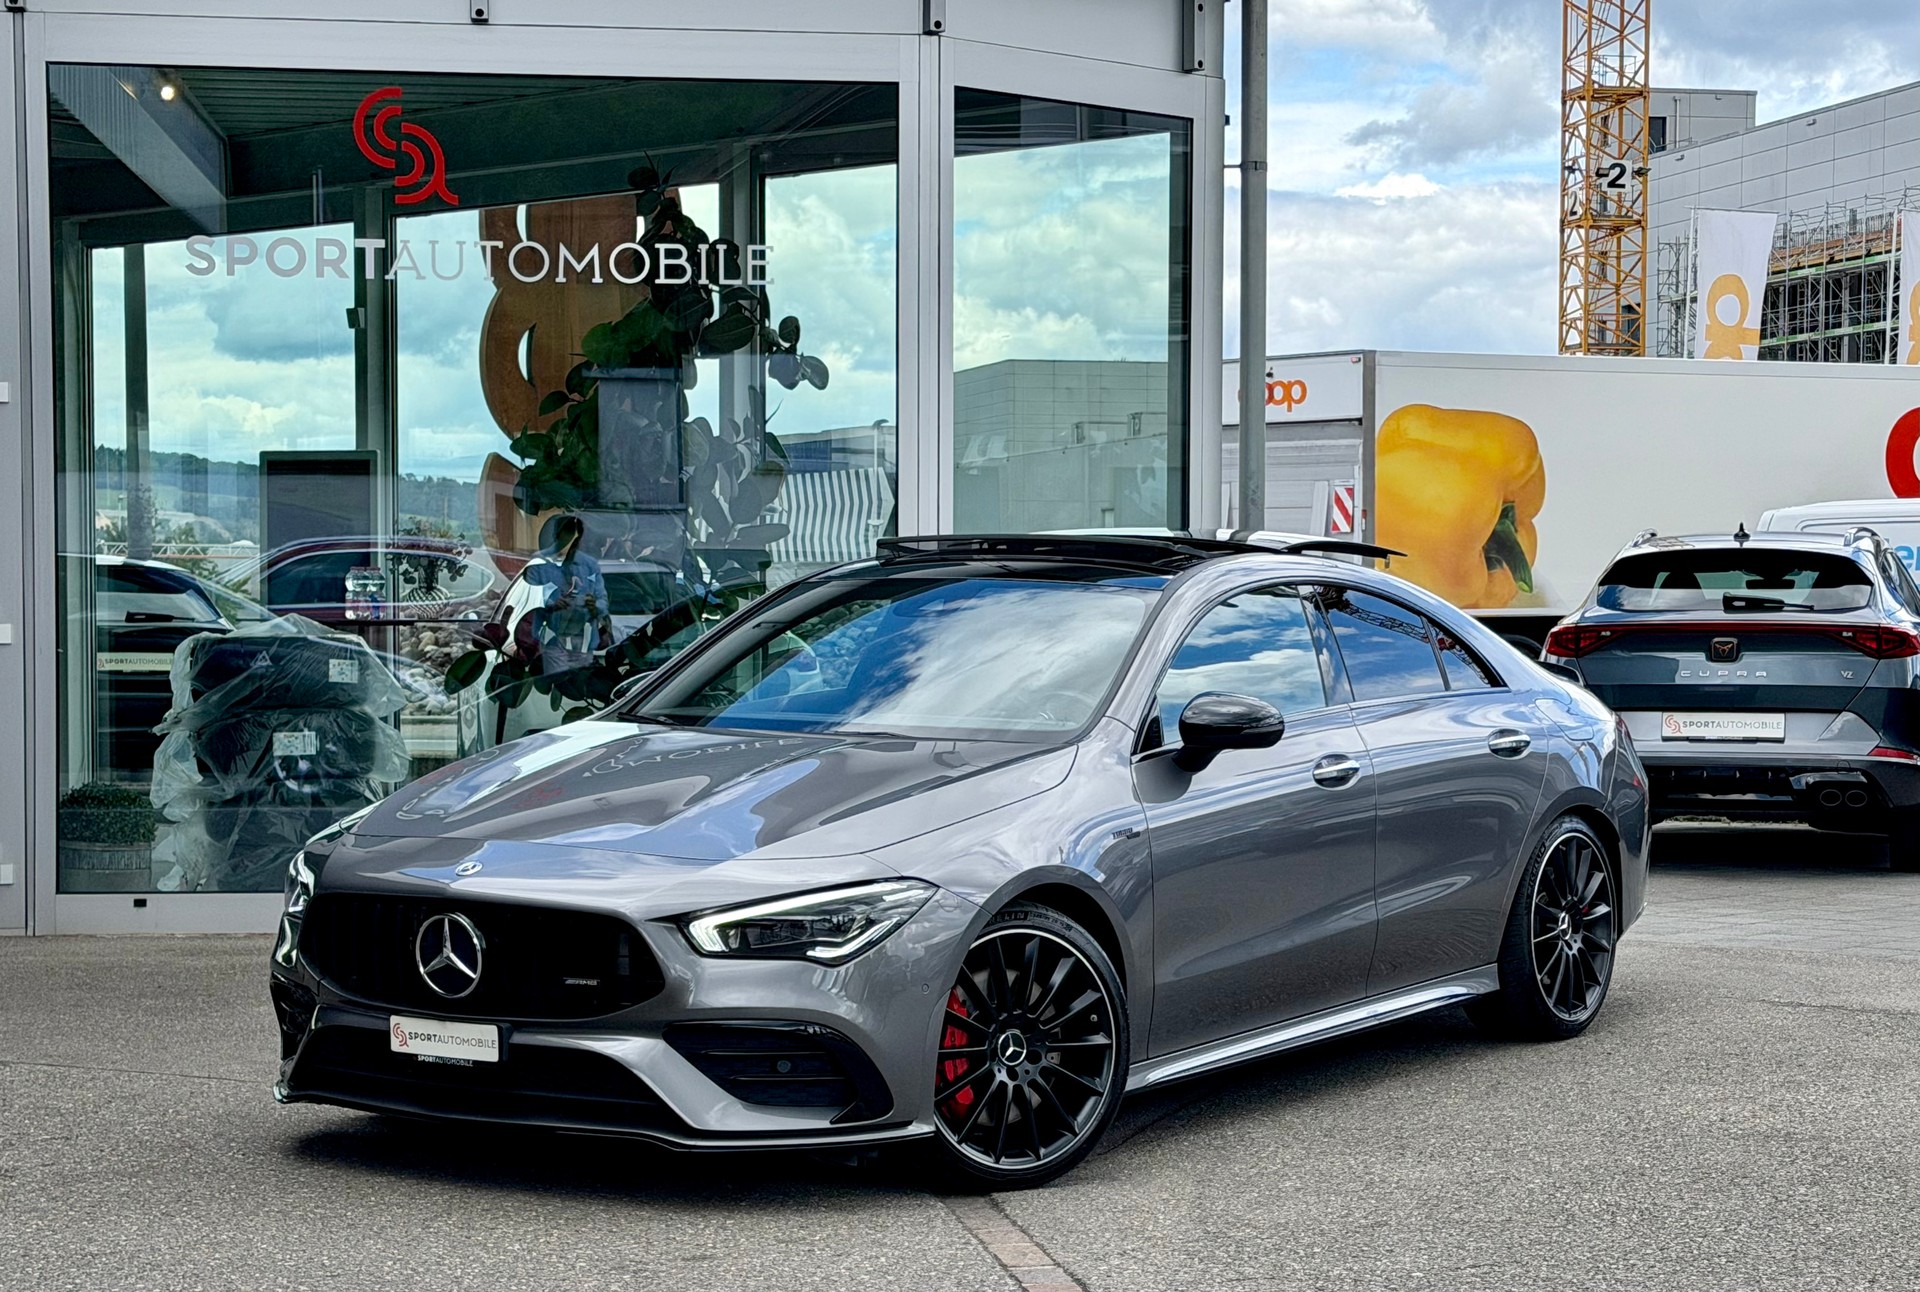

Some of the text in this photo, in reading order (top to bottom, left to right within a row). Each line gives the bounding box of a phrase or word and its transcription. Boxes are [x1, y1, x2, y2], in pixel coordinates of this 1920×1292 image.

[1606, 162, 1627, 189] 2
[1569, 189, 1578, 217] 2
[185, 234, 775, 286] SPORTAUTOMOBILE
[1680, 670, 1767, 678] CUPRA
[1840, 670, 1854, 679] VZ
[1682, 720, 1782, 730] SPORTAUTOMOBILE
[408, 1031, 497, 1049] SPORTAUTOMOBILE
[417, 1055, 474, 1067] SPORTAUTOMOBILE
